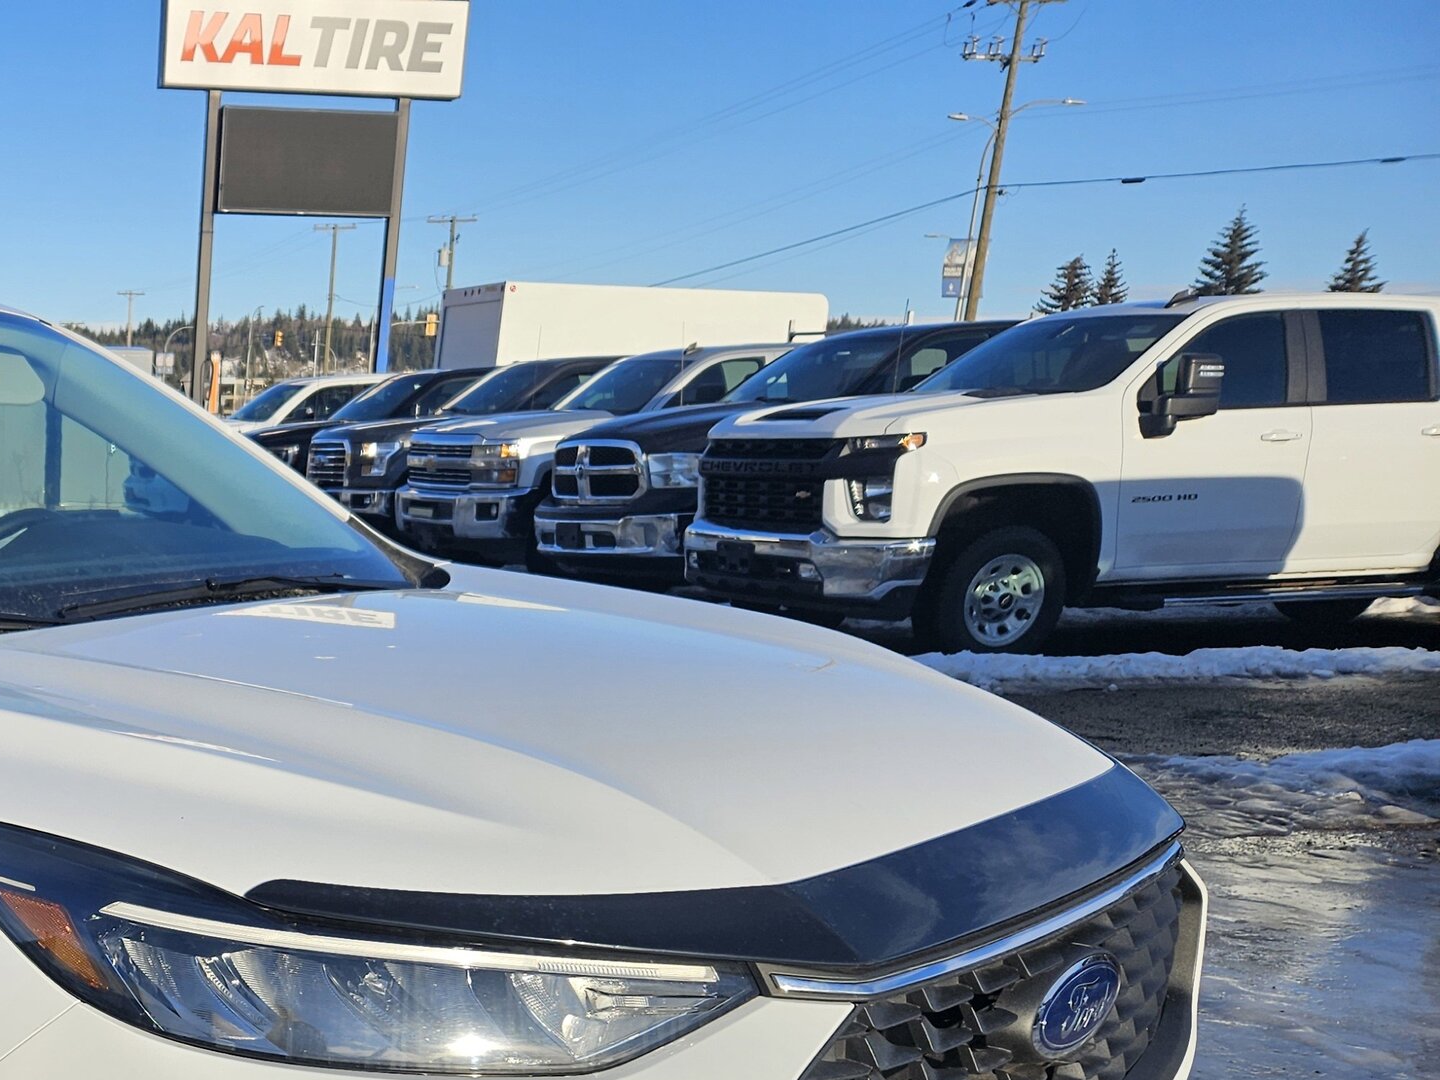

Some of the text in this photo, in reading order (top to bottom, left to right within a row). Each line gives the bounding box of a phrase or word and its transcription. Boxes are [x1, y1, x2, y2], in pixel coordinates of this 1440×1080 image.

[180, 10, 453, 73] KAL TIRE
[701, 460, 817, 473] CHEVROLET
[1131, 493, 1199, 504] 2500 HD
[1061, 976, 1113, 1040] Ford
